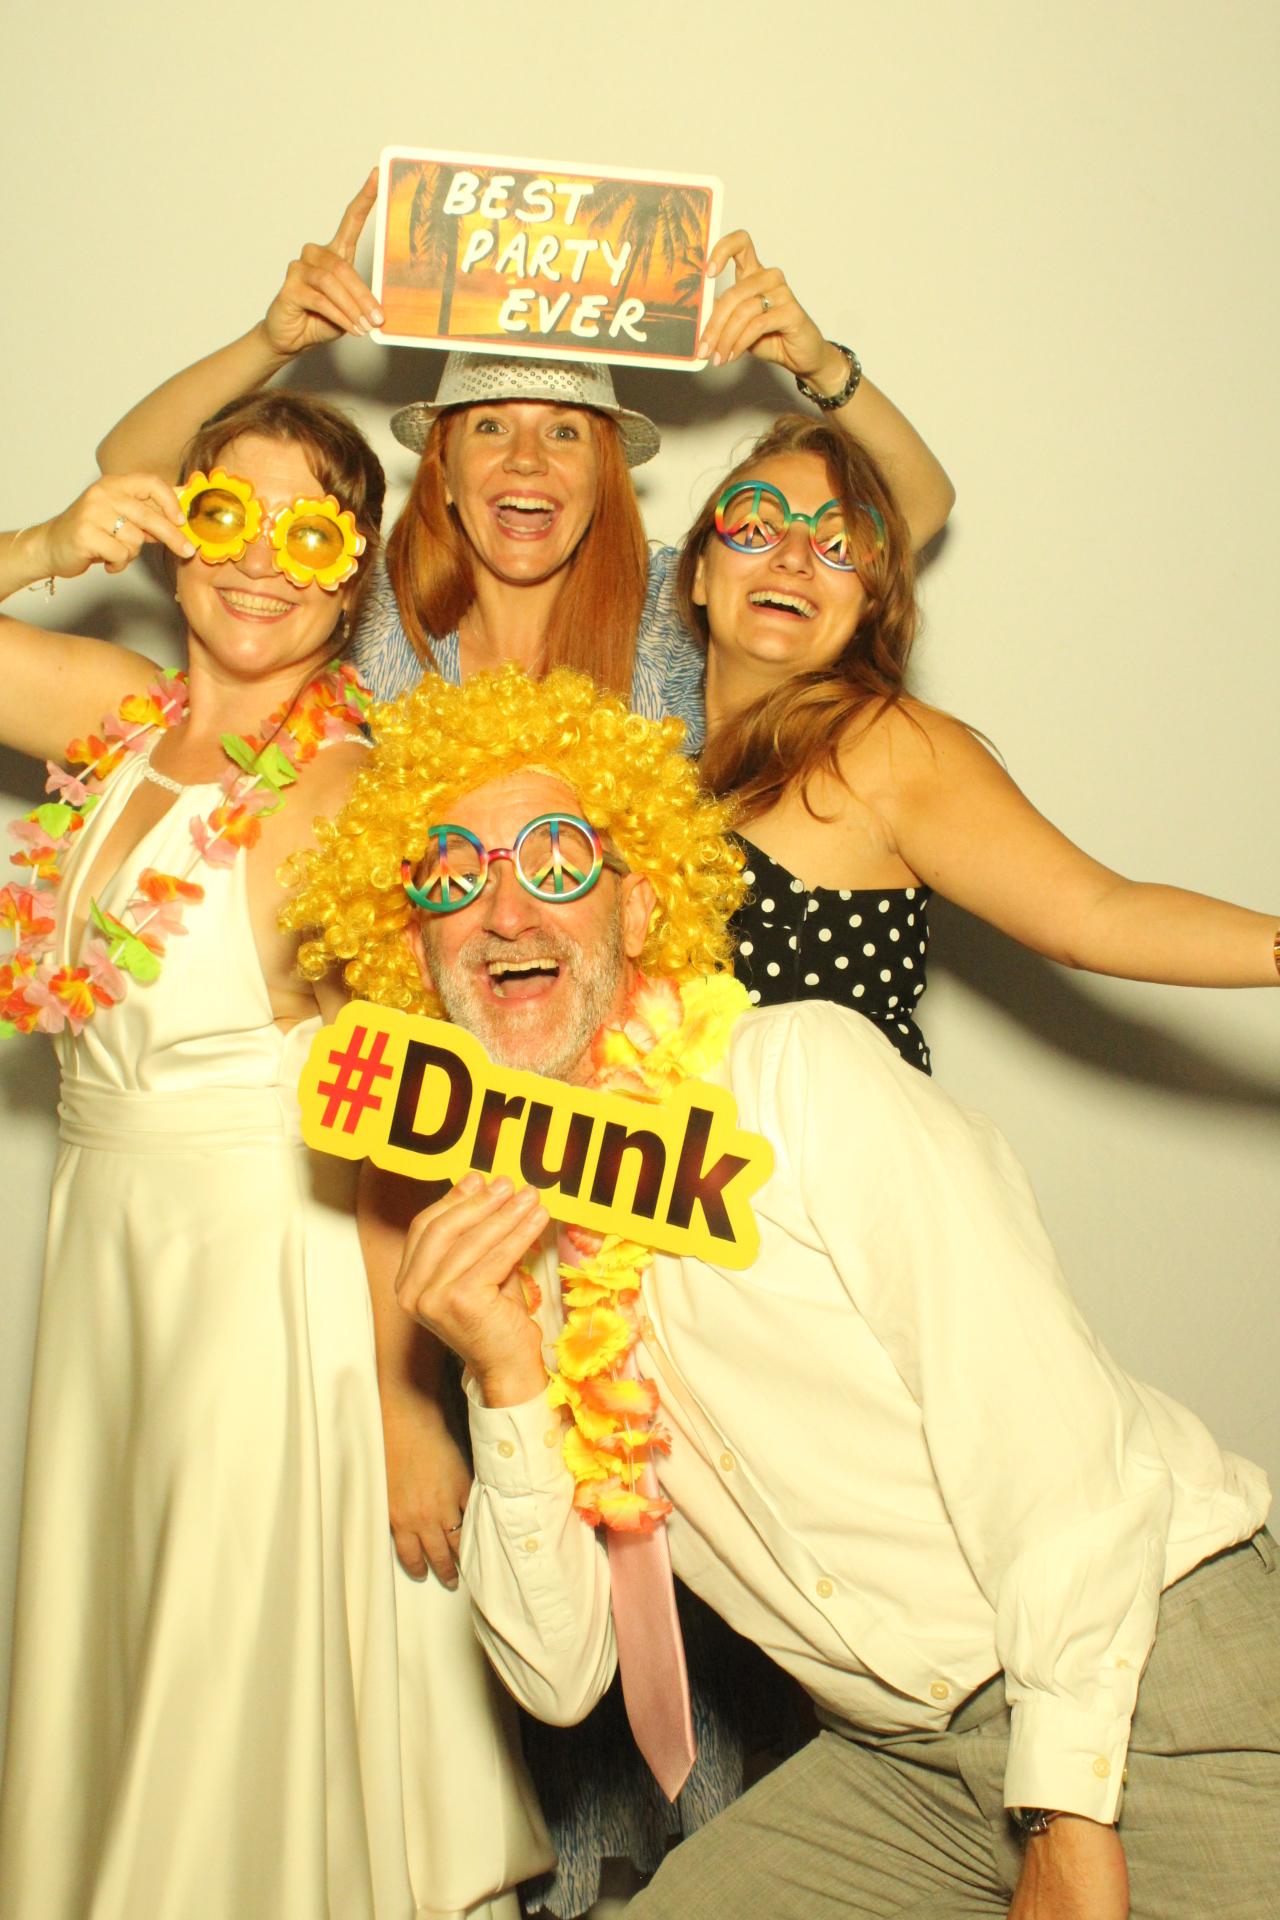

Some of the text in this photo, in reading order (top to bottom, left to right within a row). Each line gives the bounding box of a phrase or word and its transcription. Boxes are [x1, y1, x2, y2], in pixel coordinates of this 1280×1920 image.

[442, 171, 594, 225] BEST
[460, 229, 632, 287] PARTY
[497, 288, 648, 342] EVER
[316, 1025, 752, 1244] #Drunk
